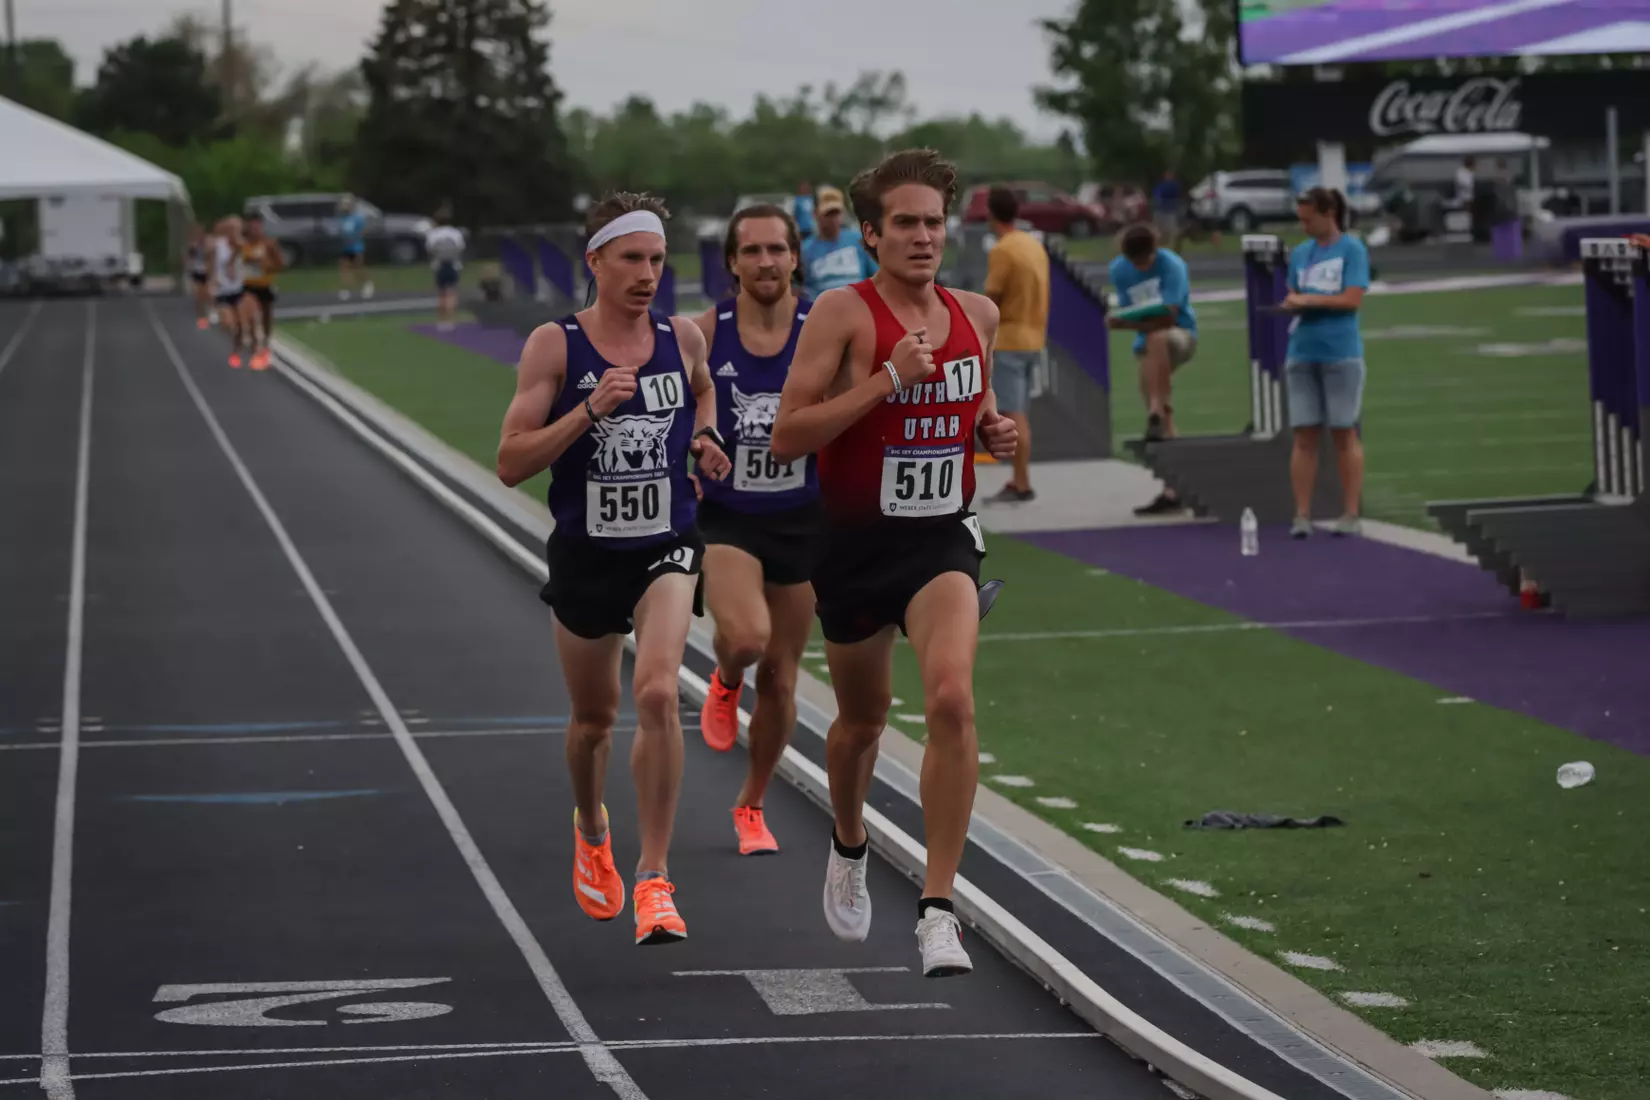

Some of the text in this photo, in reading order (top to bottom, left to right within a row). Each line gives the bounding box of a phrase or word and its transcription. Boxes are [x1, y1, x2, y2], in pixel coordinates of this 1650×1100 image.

[649, 374, 679, 407] 10
[952, 359, 974, 397] 17
[904, 415, 961, 440] UTAH
[895, 459, 954, 501] 510
[599, 483, 660, 522] 550
